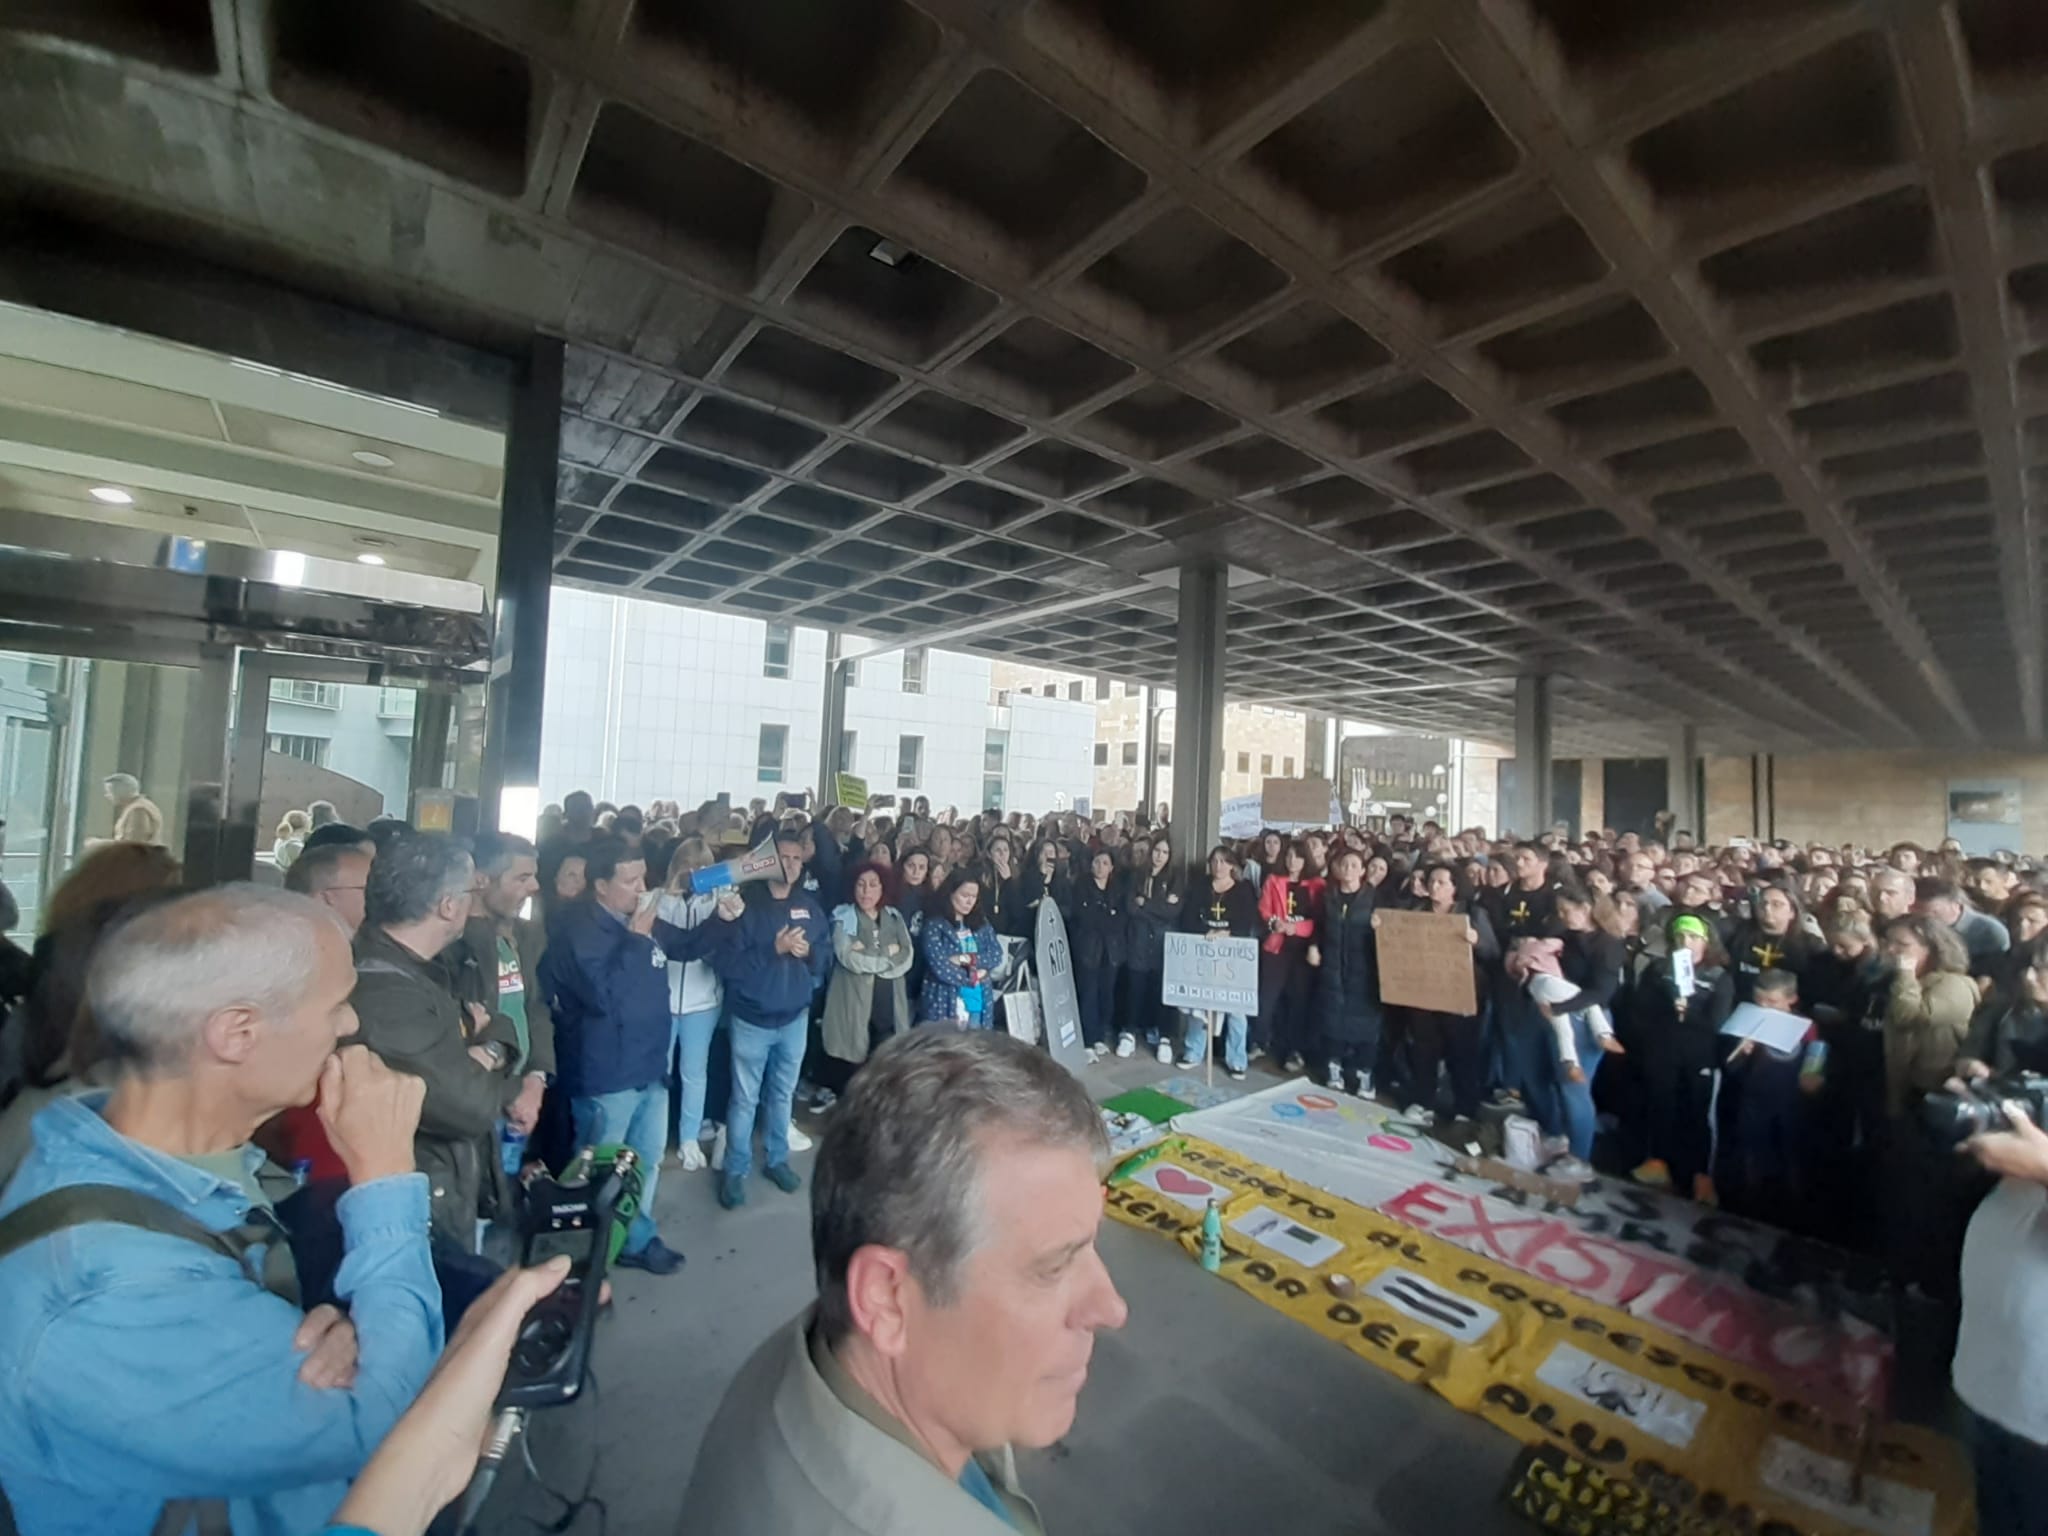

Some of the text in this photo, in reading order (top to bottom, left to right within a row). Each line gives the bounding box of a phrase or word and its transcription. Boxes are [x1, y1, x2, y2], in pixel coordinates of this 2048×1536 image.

[1181, 1151, 1922, 1463] RESPETO AL PROFESOR
[1326, 1303, 1427, 1369] DEL
